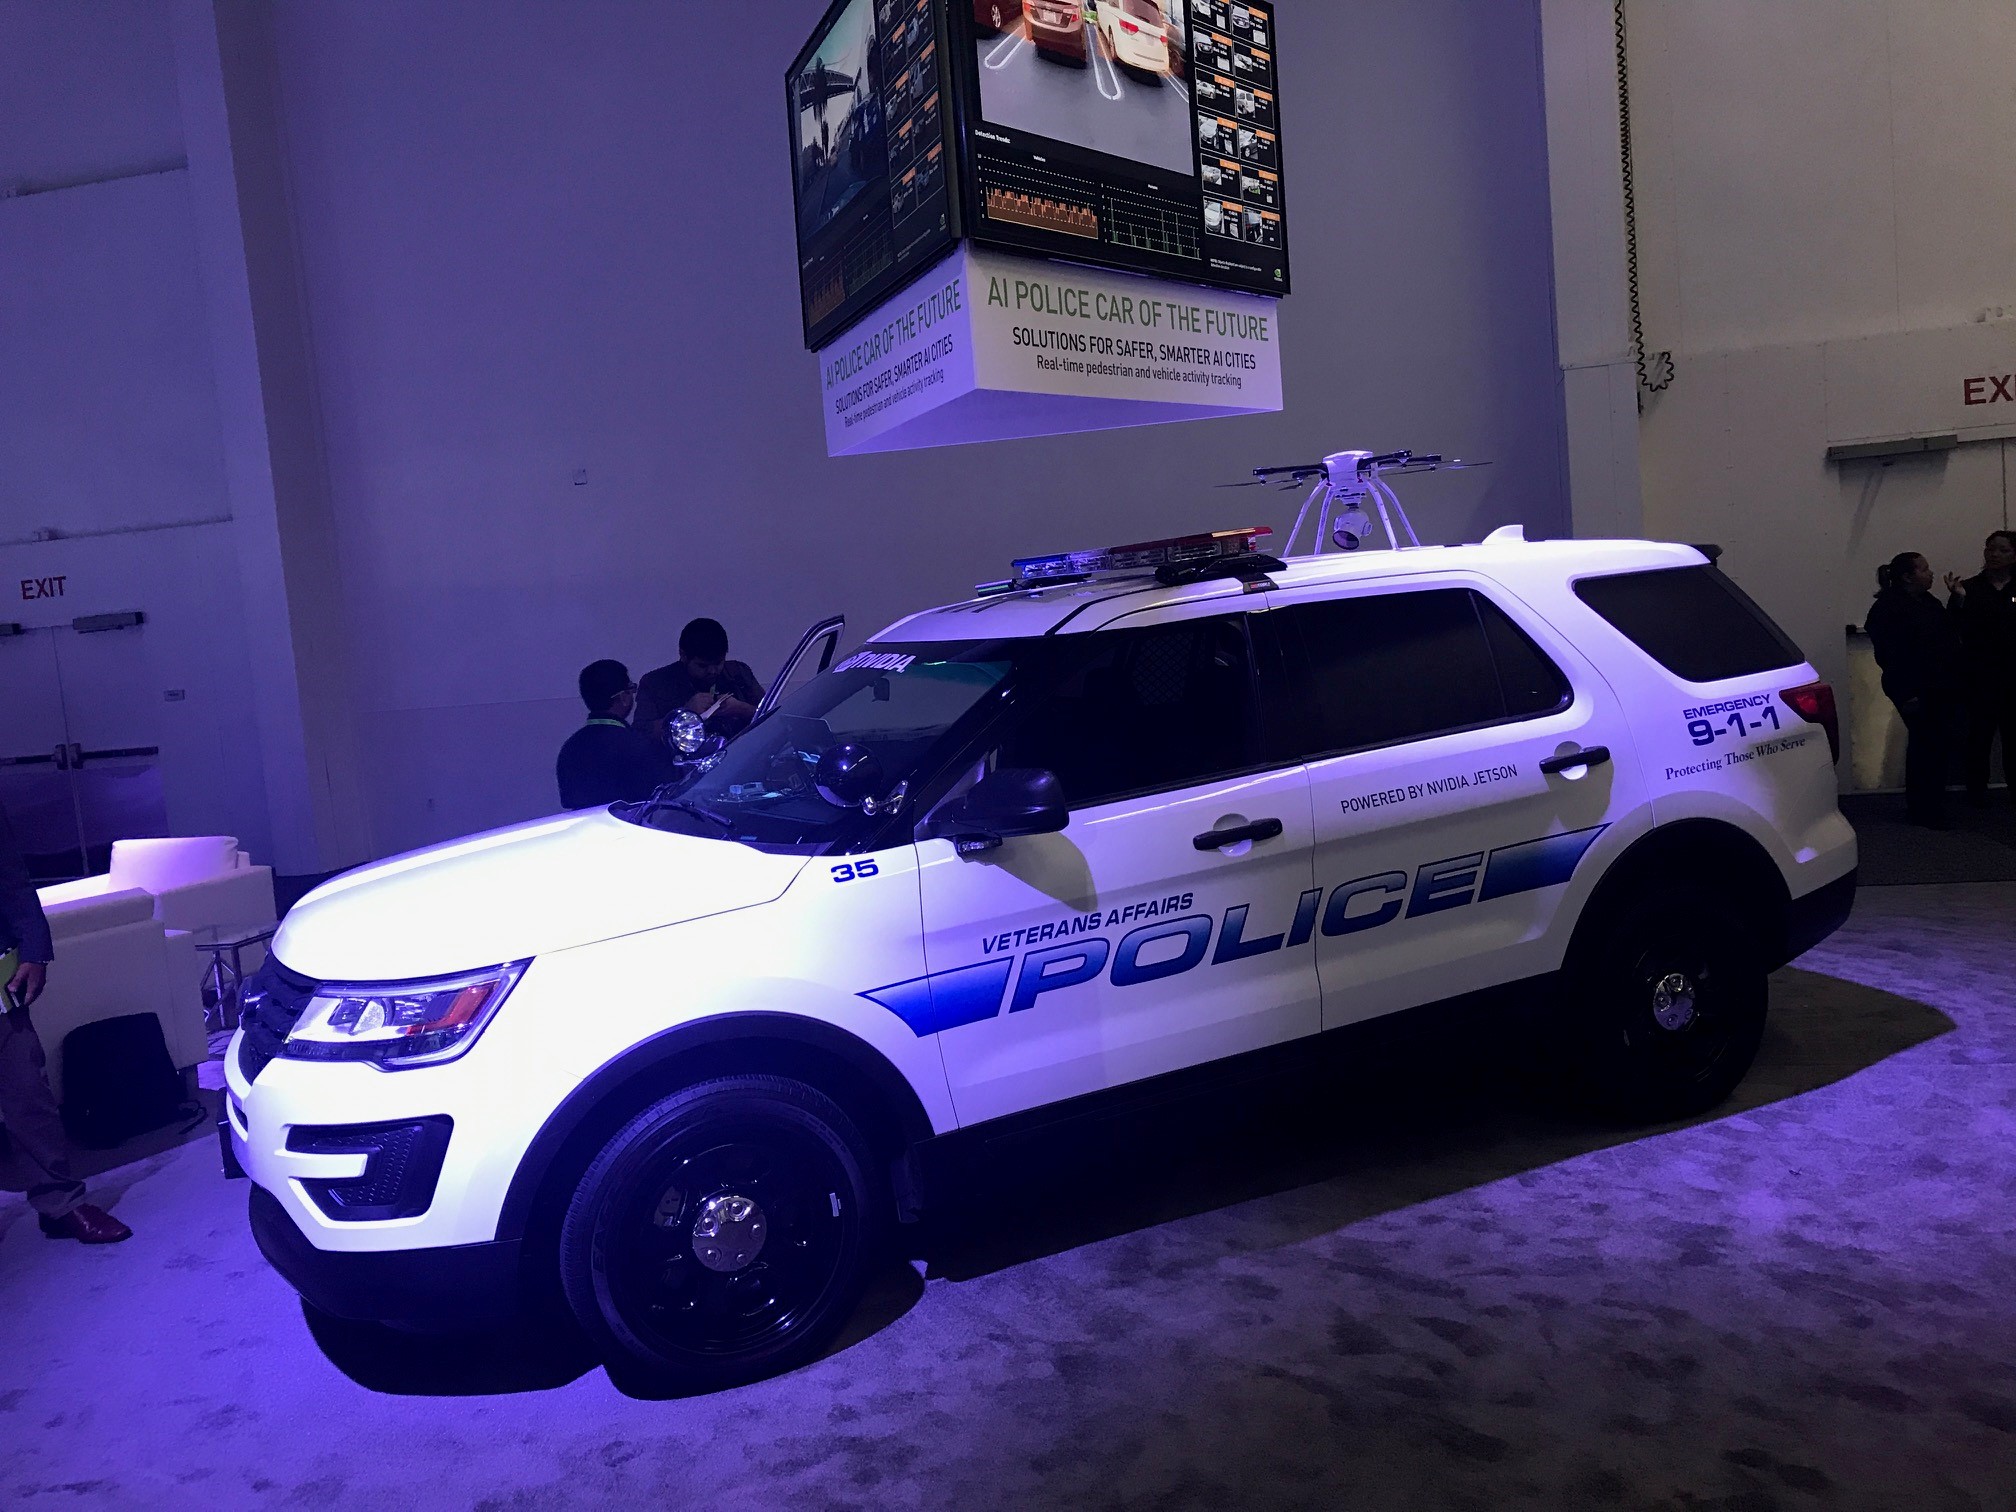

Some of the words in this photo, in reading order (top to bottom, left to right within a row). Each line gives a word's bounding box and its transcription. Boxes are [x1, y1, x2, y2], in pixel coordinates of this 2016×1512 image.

[988, 276, 1009, 308] AI
[1015, 280, 1091, 320] POLICE
[1096, 292, 1135, 325] CAR
[1139, 299, 1162, 328] OF
[1166, 303, 1201, 334] THE
[1205, 309, 1269, 342] FUTURE
[826, 366, 834, 391] AI
[834, 345, 863, 385] POLICE
[863, 333, 881, 366] CAR
[882, 323, 895, 355] OF
[896, 309, 916, 346] THE
[917, 278, 962, 333] FUTURE
[1012, 326, 1086, 353] SOLUTIONS
[1090, 336, 1114, 356] FOR
[1116, 339, 1158, 362] SAFER,
[1159, 344, 1210, 366] SMARTER
[1213, 352, 1223, 367] AI
[1225, 353, 1256, 370] CITIES
[835, 386, 863, 415] SOLUTIONS
[862, 380, 874, 398] FOR
[874, 369, 894, 394] SAFER,
[894, 351, 924, 383] SMARTER
[924, 346, 931, 364] AI
[931, 333, 953, 362] CITIES
[883, 395, 892, 409] and
[891, 387, 907, 405] vehicle
[907, 376, 924, 397] activity
[923, 368, 944, 386] tracking
[1037, 354, 1084, 373] Real-time
[1086, 363, 1133, 378] pedestrian
[1135, 366, 1150, 379] and
[1152, 367, 1181, 382] vehicle
[1182, 370, 1209, 387] activity
[1210, 373, 1242, 389] tracking
[1964, 374, 2016, 405] EX
[21, 576, 66, 599] EXIT
[1682, 693, 1770, 720] EMERGENCY
[1687, 705, 1780, 746] 9-1-1
[1665, 758, 1723, 781] Protecting
[1724, 752, 1754, 765] Those
[1755, 743, 1779, 758] Who
[1780, 738, 1806, 751] Serve
[1340, 788, 1406, 814] POWERED
[1407, 784, 1424, 800] BY
[1426, 775, 1470, 795] NVIDIA
[1472, 764, 1518, 786] JETSON
[831, 858, 879, 883] 35
[982, 912, 1102, 954] VETERANS
[1104, 892, 1194, 927] AFFAIRS
[1009, 851, 1484, 1014] POLICE
